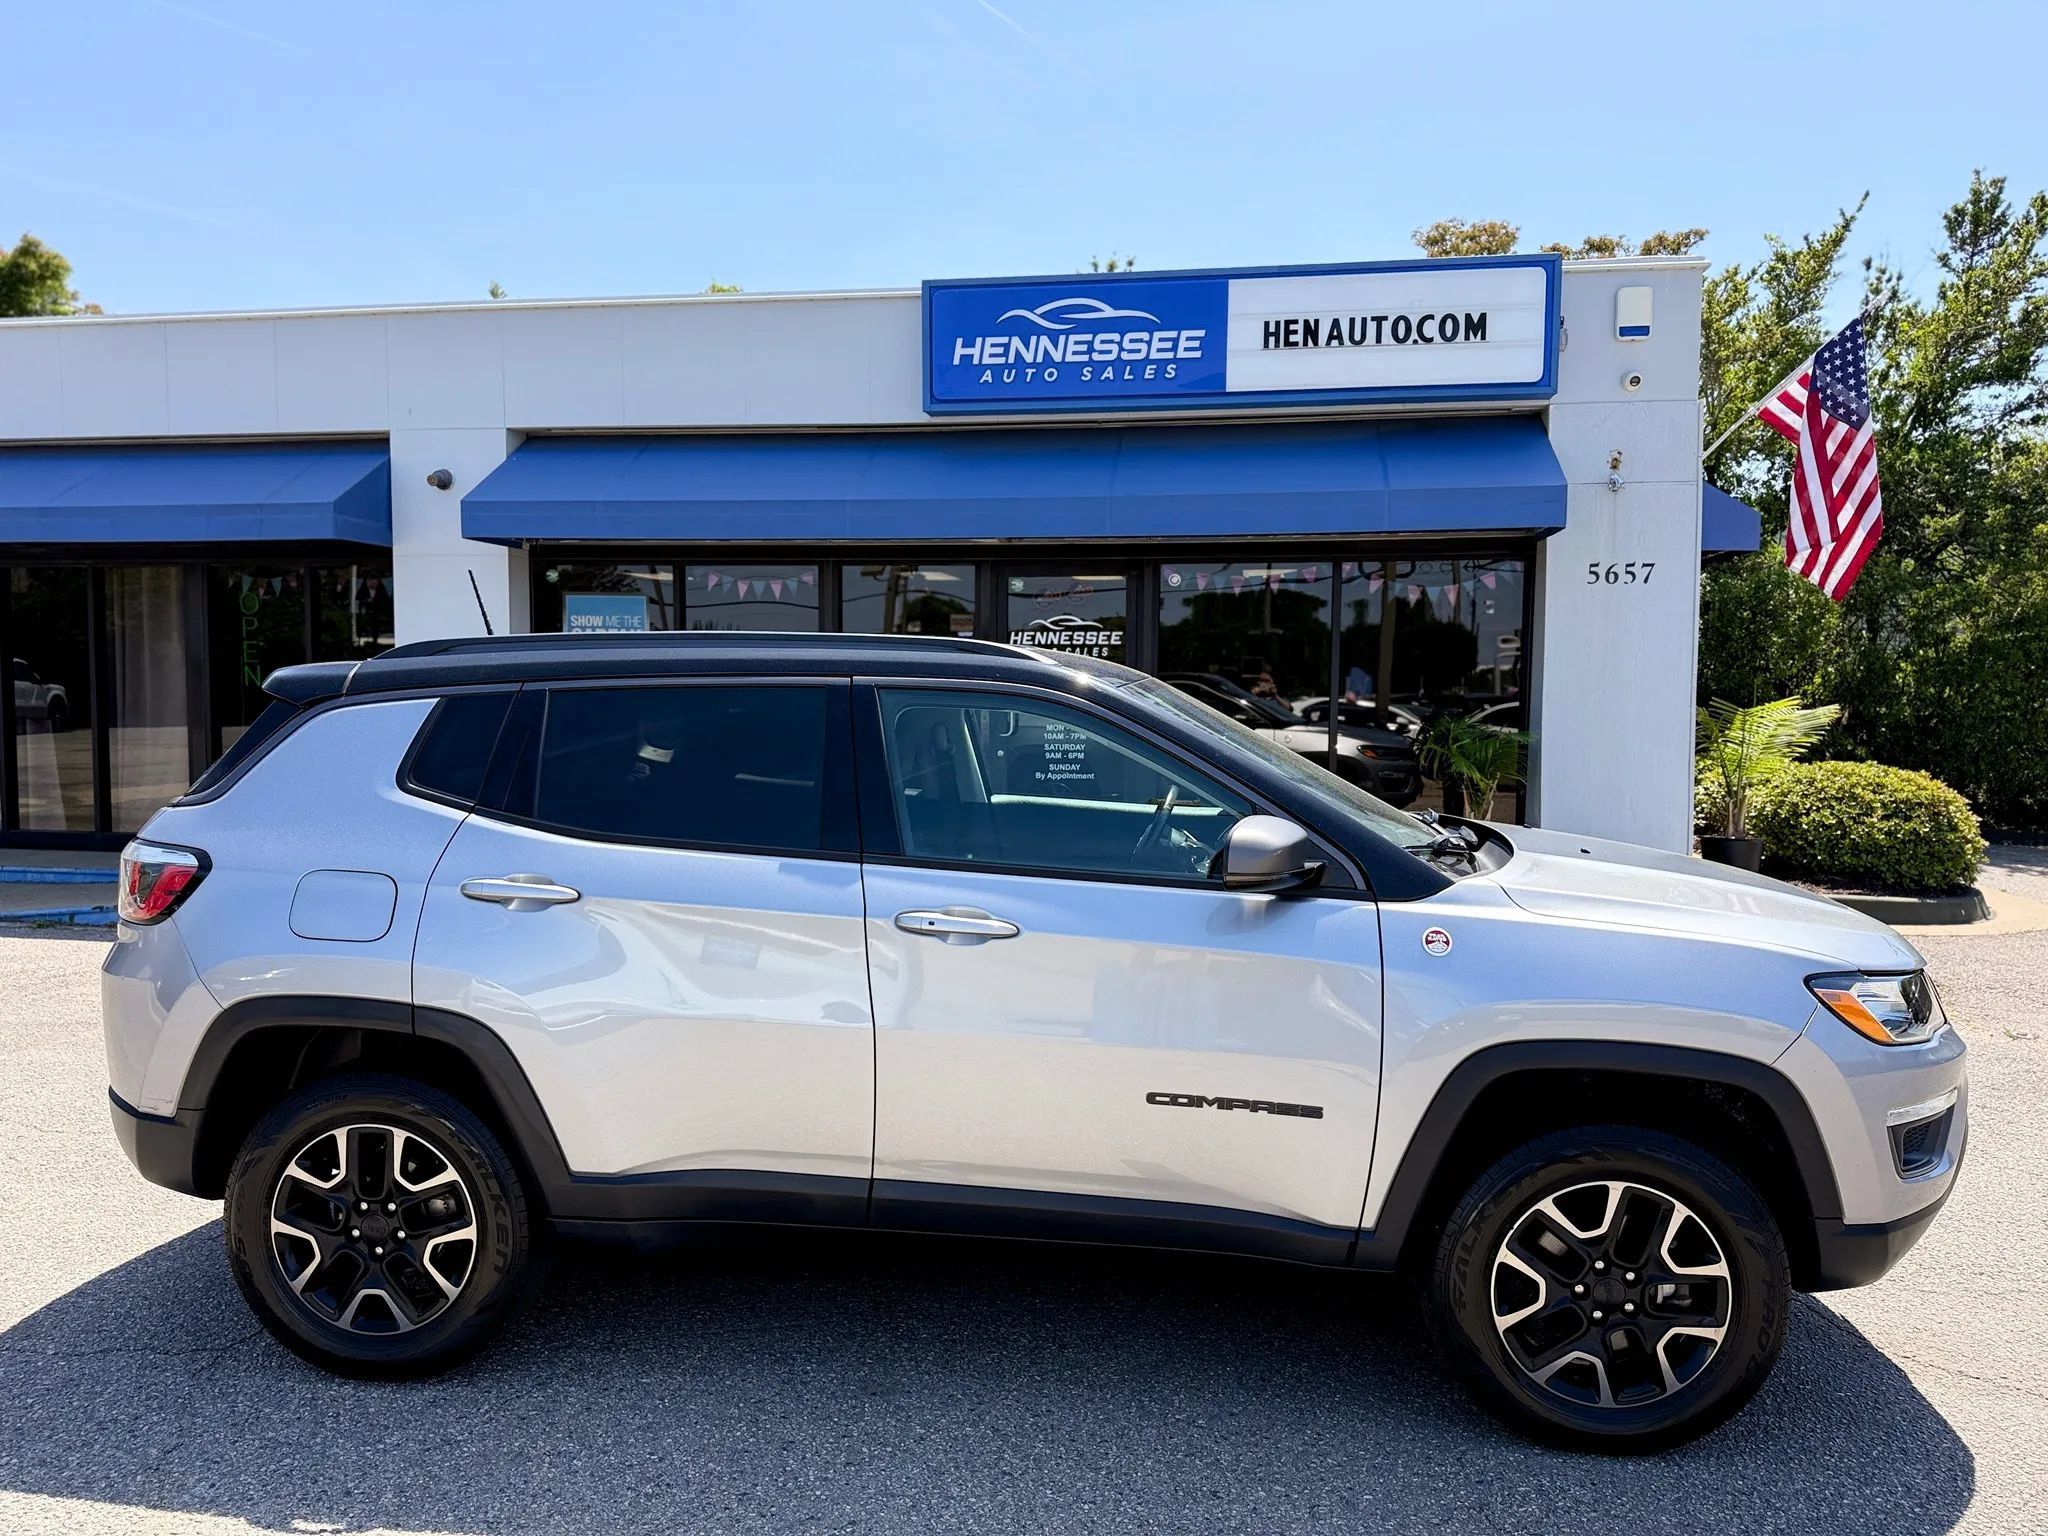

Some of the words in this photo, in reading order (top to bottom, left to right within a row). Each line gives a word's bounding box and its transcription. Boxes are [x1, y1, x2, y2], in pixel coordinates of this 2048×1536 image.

[952, 329, 1206, 366] HENNESSEE
[979, 367, 1058, 384] AUTO
[1080, 363, 1177, 381] SALES
[1587, 561, 1656, 585] 5657
[570, 615, 603, 627] SHOW
[605, 615, 621, 627] ME
[623, 615, 642, 627] THE
[240, 592, 260, 687] OPEN
[1009, 631, 1124, 645] HENNESSEE
[1043, 732, 1064, 740] 10AM
[1044, 743, 1086, 751] SATURDAY
[1049, 763, 1081, 771] SUNDAY
[1035, 772, 1046, 780] By
[1047, 772, 1095, 780] Appointment
[1145, 1091, 1324, 1120] COMPASS
